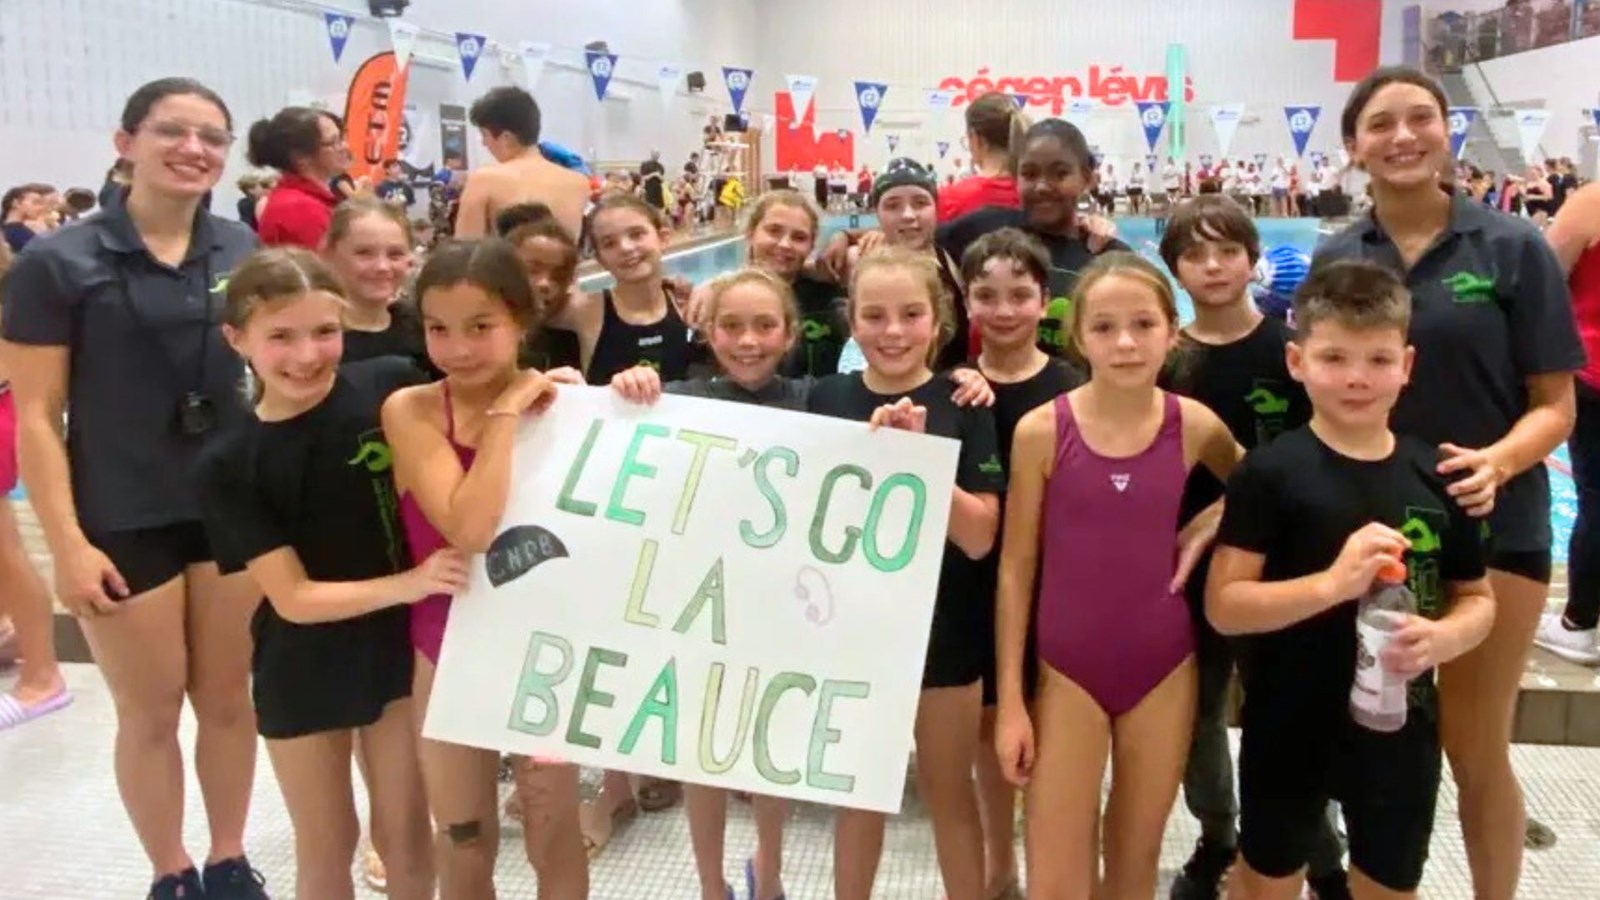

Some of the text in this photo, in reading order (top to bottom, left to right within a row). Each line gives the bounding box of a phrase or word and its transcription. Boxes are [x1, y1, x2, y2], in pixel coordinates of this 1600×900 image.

[556, 419, 927, 572] LET'S GO
[625, 539, 726, 644] LA
[508, 631, 870, 792] BEAUCE
